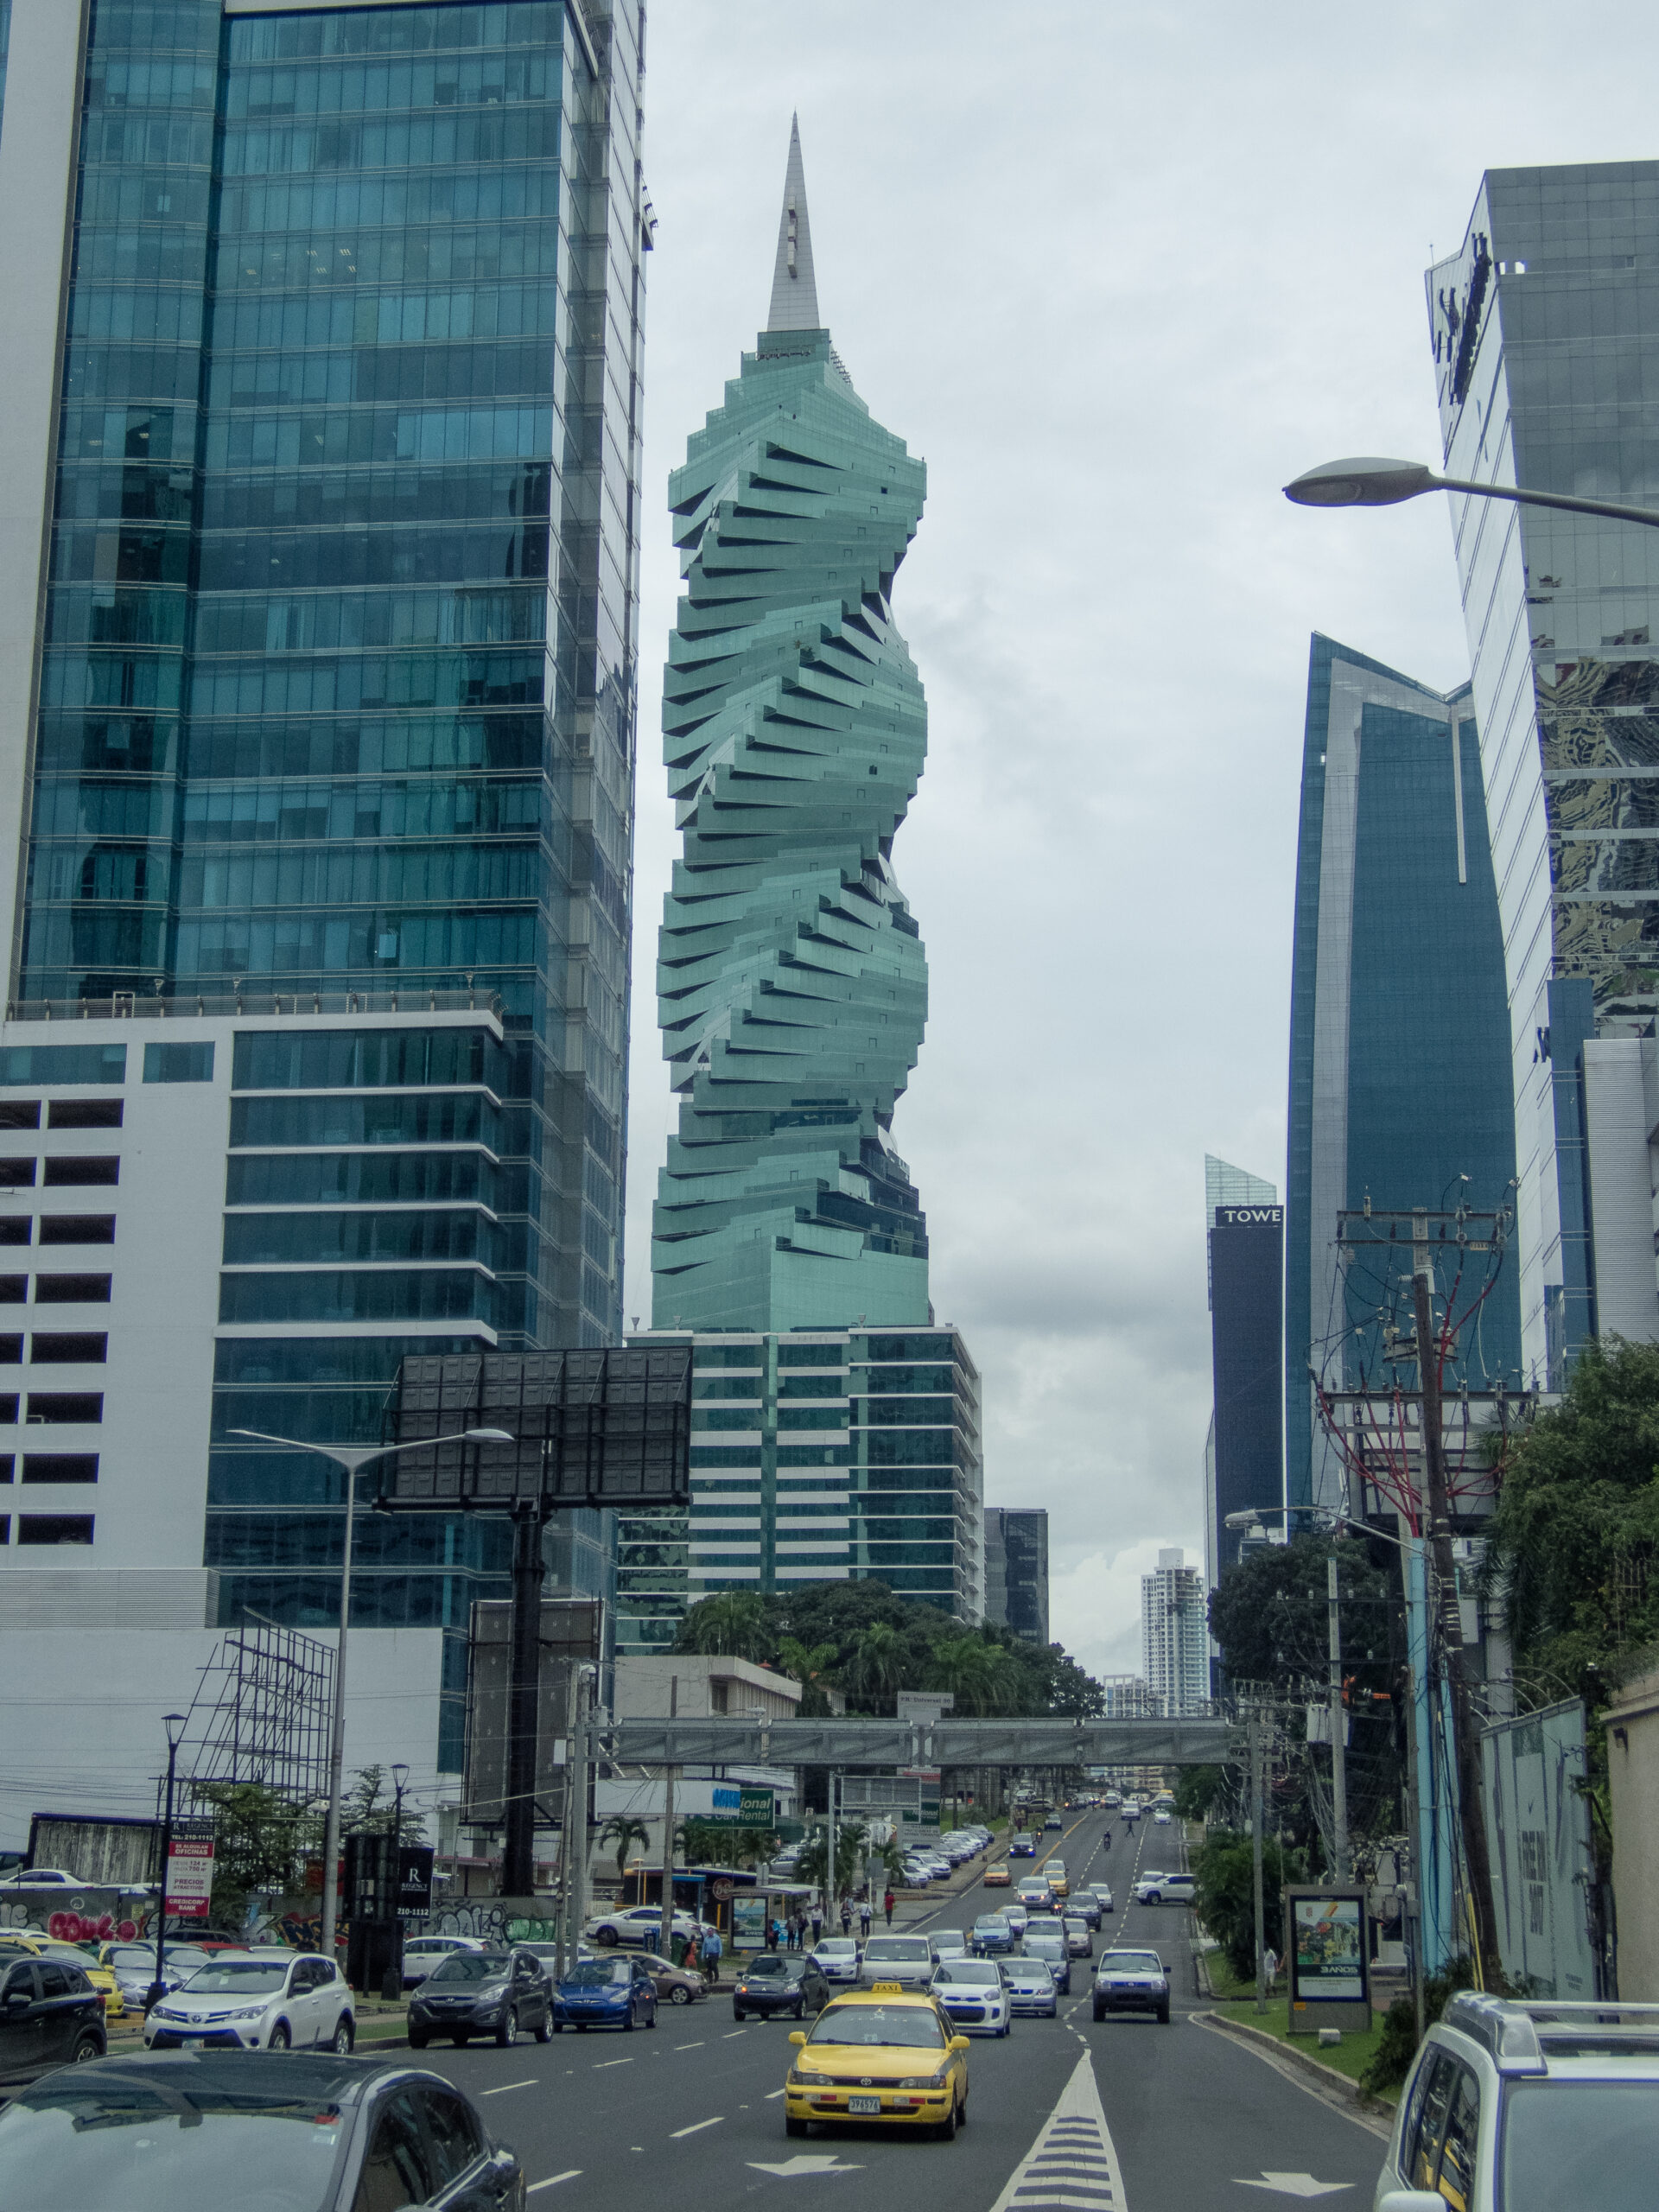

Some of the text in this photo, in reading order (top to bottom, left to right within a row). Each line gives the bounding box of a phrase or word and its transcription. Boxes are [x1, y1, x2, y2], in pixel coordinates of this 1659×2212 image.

[1224, 1210, 1281, 1222] TOWE
[740, 1798, 771, 1808] ional
[737, 1811, 770, 1821] Rental
[408, 1867, 422, 1883] R
